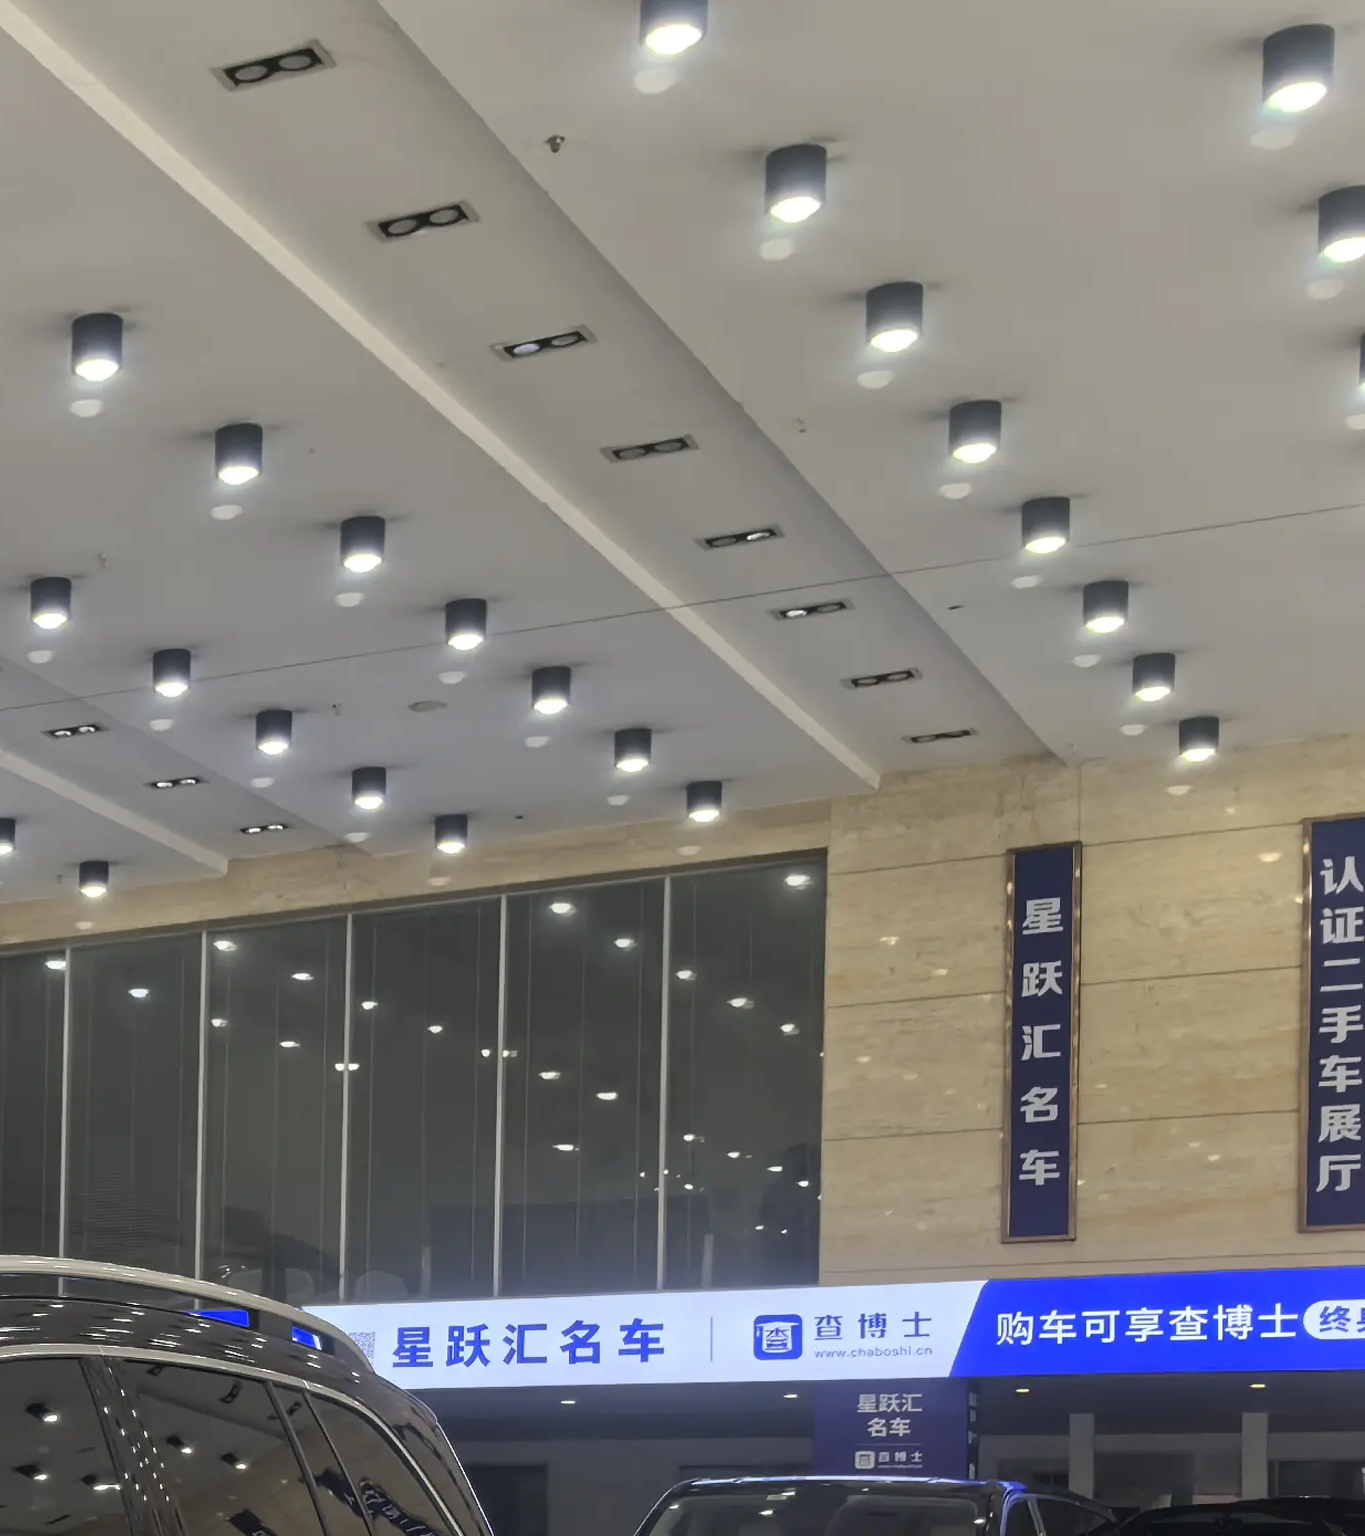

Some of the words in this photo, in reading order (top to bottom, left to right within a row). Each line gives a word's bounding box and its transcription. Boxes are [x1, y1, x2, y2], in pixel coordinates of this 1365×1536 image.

[1019, 897, 1064, 1186] 星跃汇名车
[1316, 855, 1365, 1192] 认证二手车展厅
[392, 1317, 666, 1369] 星跃汇名车
[814, 1311, 933, 1342] 查博士
[995, 1303, 1299, 1346] 购车可享查博士
[814, 1344, 933, 1360] www.chaboshi.cn
[857, 1393, 923, 1413] 星跃汇
[867, 1417, 911, 1437] 名车
